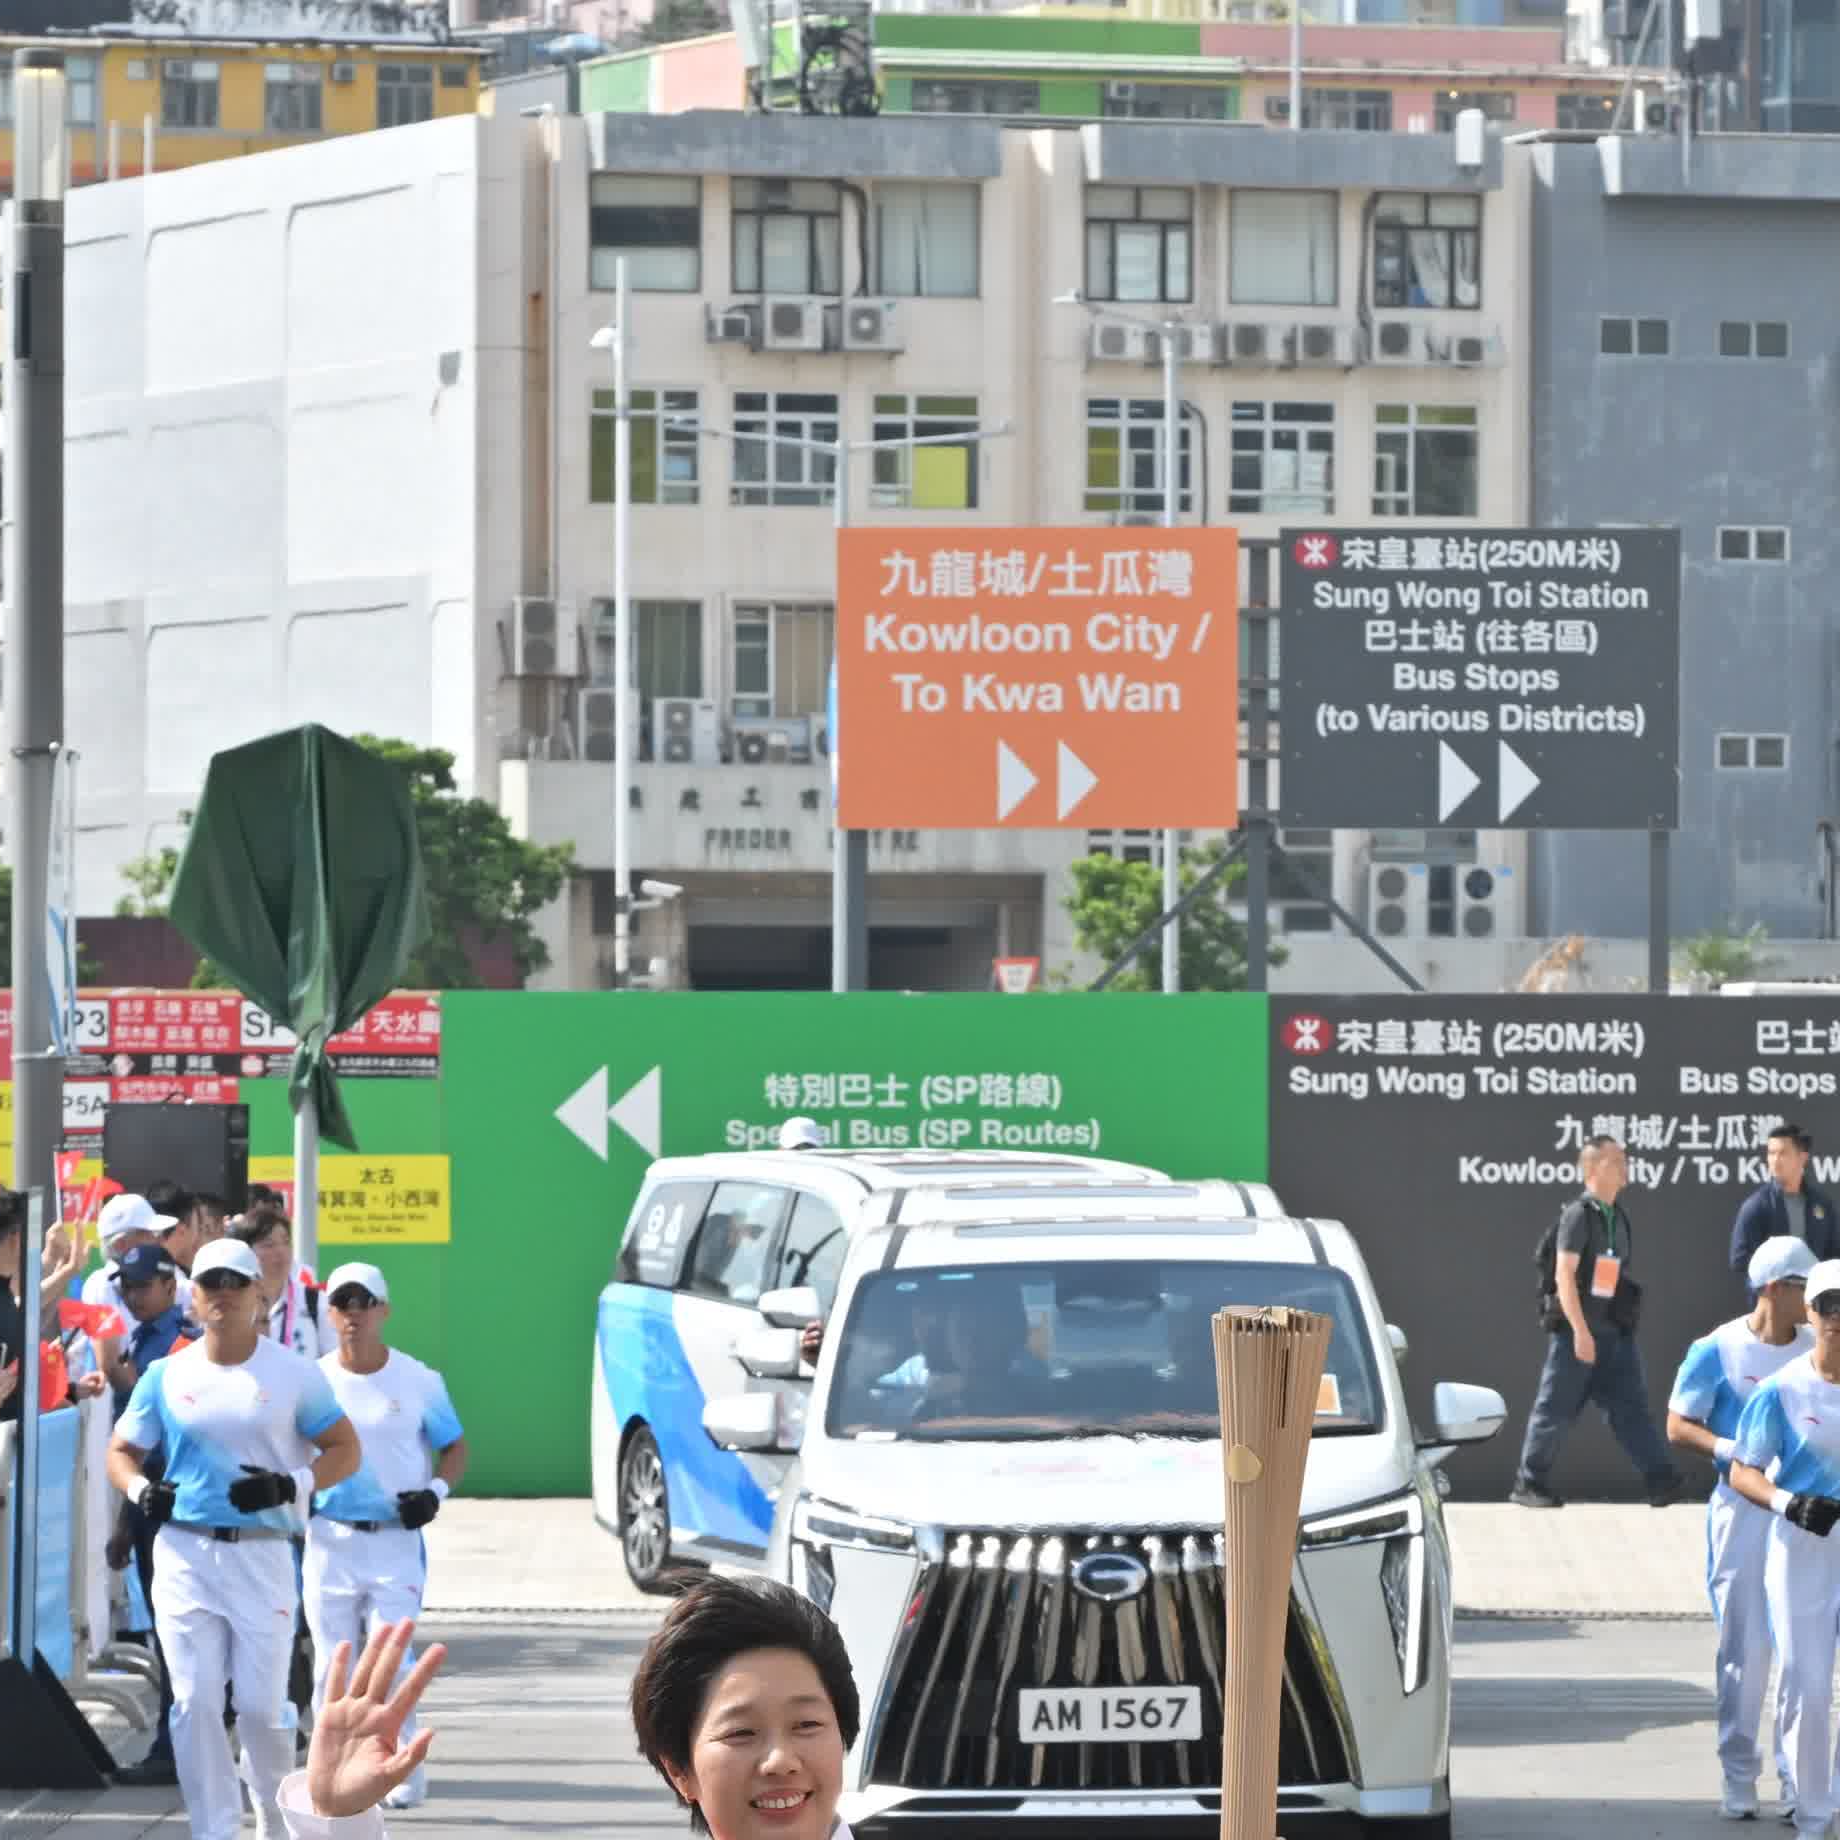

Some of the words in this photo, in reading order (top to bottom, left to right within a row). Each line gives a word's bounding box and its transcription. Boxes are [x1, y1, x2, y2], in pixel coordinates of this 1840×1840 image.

[880, 548, 1194, 598] 九龍城/土瓜灣
[1313, 581, 1390, 614] Sung
[1395, 581, 1481, 614] Wong
[1487, 581, 1532, 609] Toi
[1539, 581, 1649, 609] Station
[865, 612, 1071, 653] Kowloon
[1086, 612, 1179, 661] City
[1364, 619, 1466, 653] 巴士站
[1475, 619, 1598, 655] (往各區)
[891, 673, 948, 712] To
[962, 673, 1064, 712] Kwa
[1078, 673, 1181, 712] Wan
[1393, 663, 1456, 691] Bus
[1464, 663, 1560, 696] Stops
[1316, 703, 1359, 737] (to
[1367, 703, 1489, 732] Various
[1499, 703, 1645, 737] Districts)
[1337, 1019, 1482, 1056] 宋皇臺站
[1493, 1019, 1645, 1059] (250M米)
[765, 1073, 909, 1108] 特別巴士
[920, 1074, 1062, 1110] (SP路線)
[1288, 1066, 1368, 1100] Sung
[1376, 1066, 1465, 1100] Wong
[1473, 1066, 1518, 1095] Toi
[1526, 1066, 1637, 1095] Station
[1680, 1067, 1739, 1094] Bus
[1747, 1066, 1836, 1099] Stops
[850, 1119, 910, 1145] Bus
[918, 1119, 972, 1149] (SP
[981, 1118, 1100, 1149] Routes)
[1629, 1156, 1664, 1188] ity
[1692, 1157, 1729, 1184] To
[1032, 1699, 1082, 1731] AM
[1100, 1698, 1189, 1730] 1567
